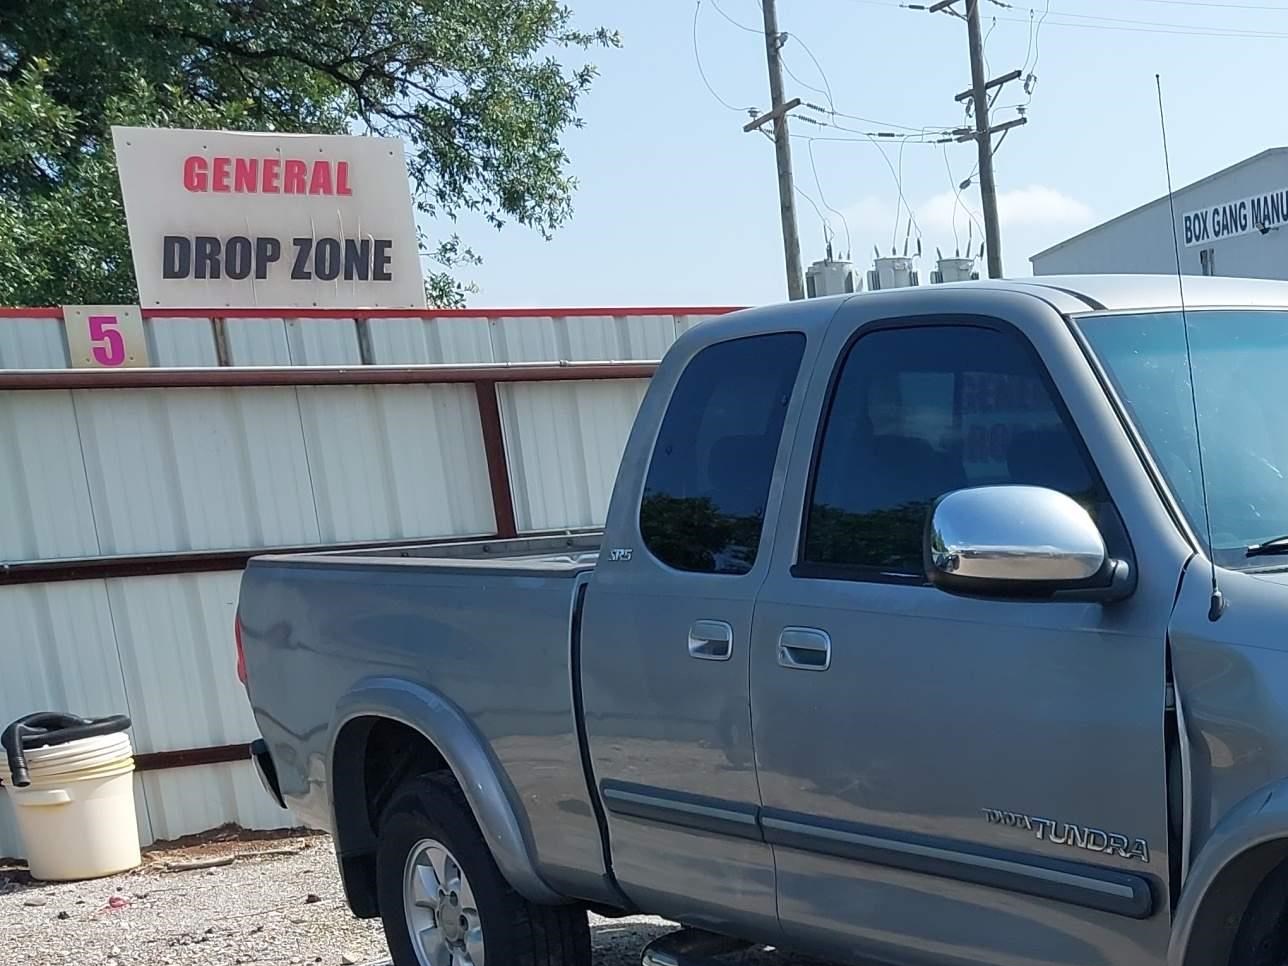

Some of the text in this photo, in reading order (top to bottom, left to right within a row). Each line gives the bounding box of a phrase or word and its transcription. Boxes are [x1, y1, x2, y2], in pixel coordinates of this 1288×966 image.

[183, 156, 353, 196] GENERAL
[1184, 210, 1210, 245] BOX
[1212, 201, 1248, 238] GANG
[162, 235, 392, 281] DROP ZONE
[88, 316, 125, 367] 5
[1031, 816, 1150, 863] TUNDRA
